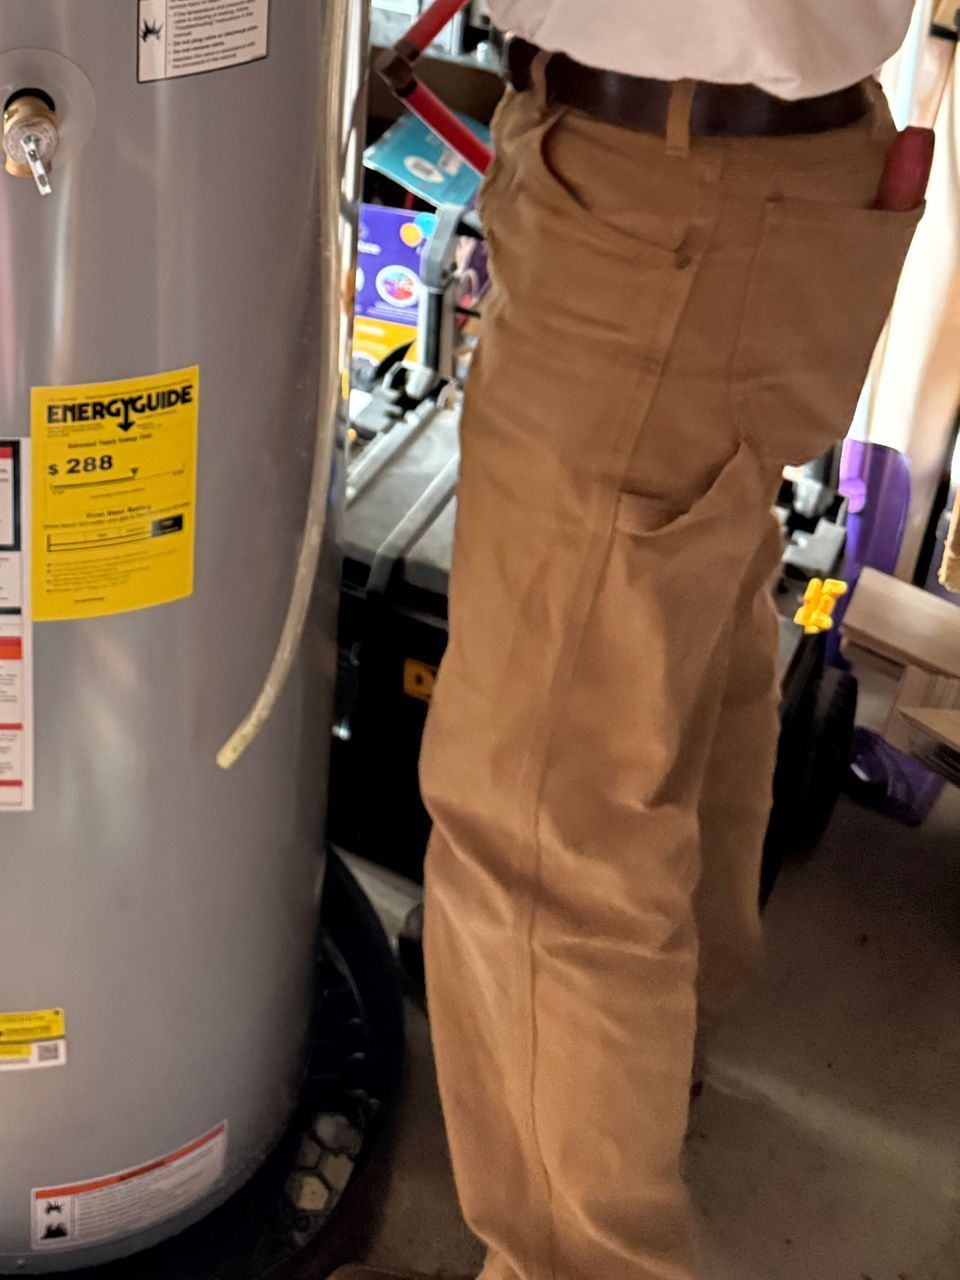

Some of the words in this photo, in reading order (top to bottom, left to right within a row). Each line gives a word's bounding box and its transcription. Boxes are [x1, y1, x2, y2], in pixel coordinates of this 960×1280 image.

[47, 385, 193, 424] ENERGYGUIDE
[48, 463, 59, 476] $
[66, 455, 113, 475] 288
